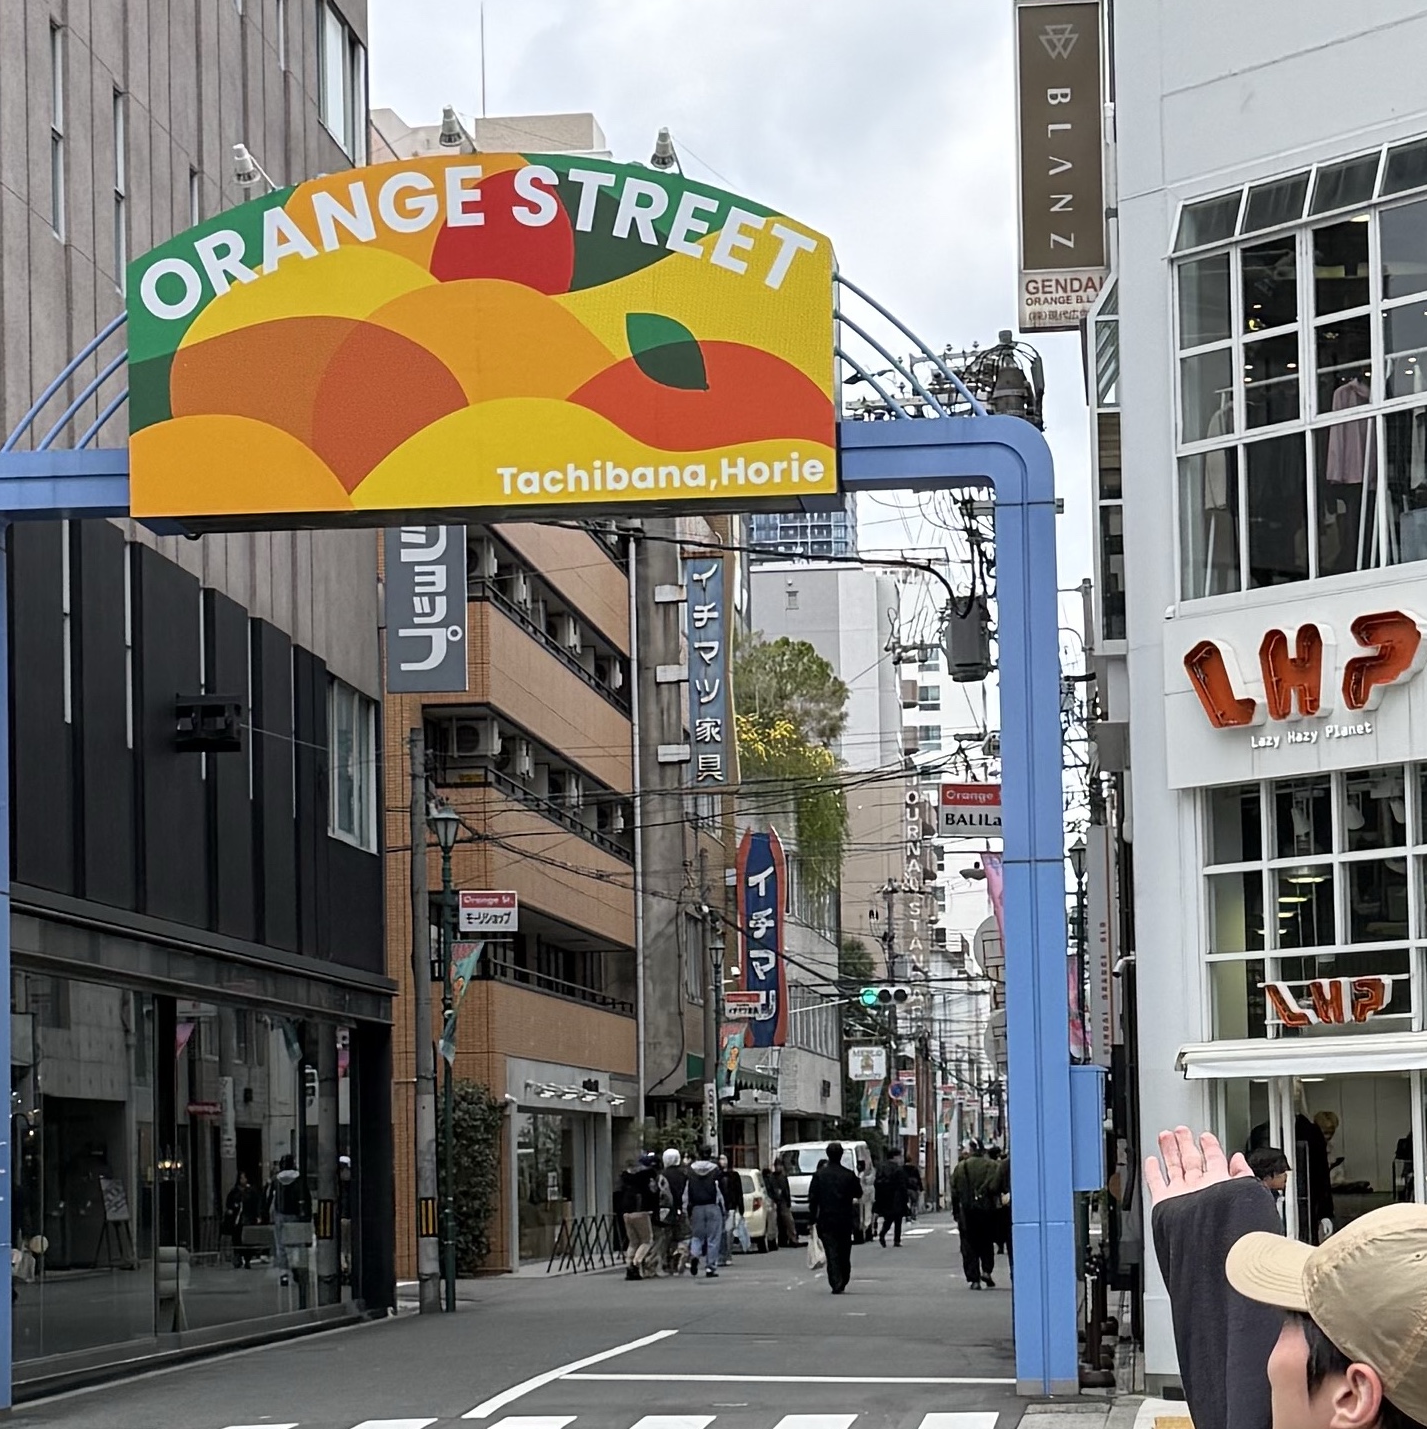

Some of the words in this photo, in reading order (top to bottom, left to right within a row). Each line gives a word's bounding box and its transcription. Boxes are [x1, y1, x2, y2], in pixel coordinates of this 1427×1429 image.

[139, 164, 486, 321] ORANGE
[511, 164, 819, 290] STREET
[1025, 296, 1073, 307] ORANGE
[692, 563, 724, 781] イチマツ家具
[1251, 735, 1280, 749] Lazy
[1287, 730, 1318, 745] Hazy
[1325, 721, 1373, 738] Planet
[946, 790, 994, 803] Orange
[1264, 977, 1392, 1028] LHP
